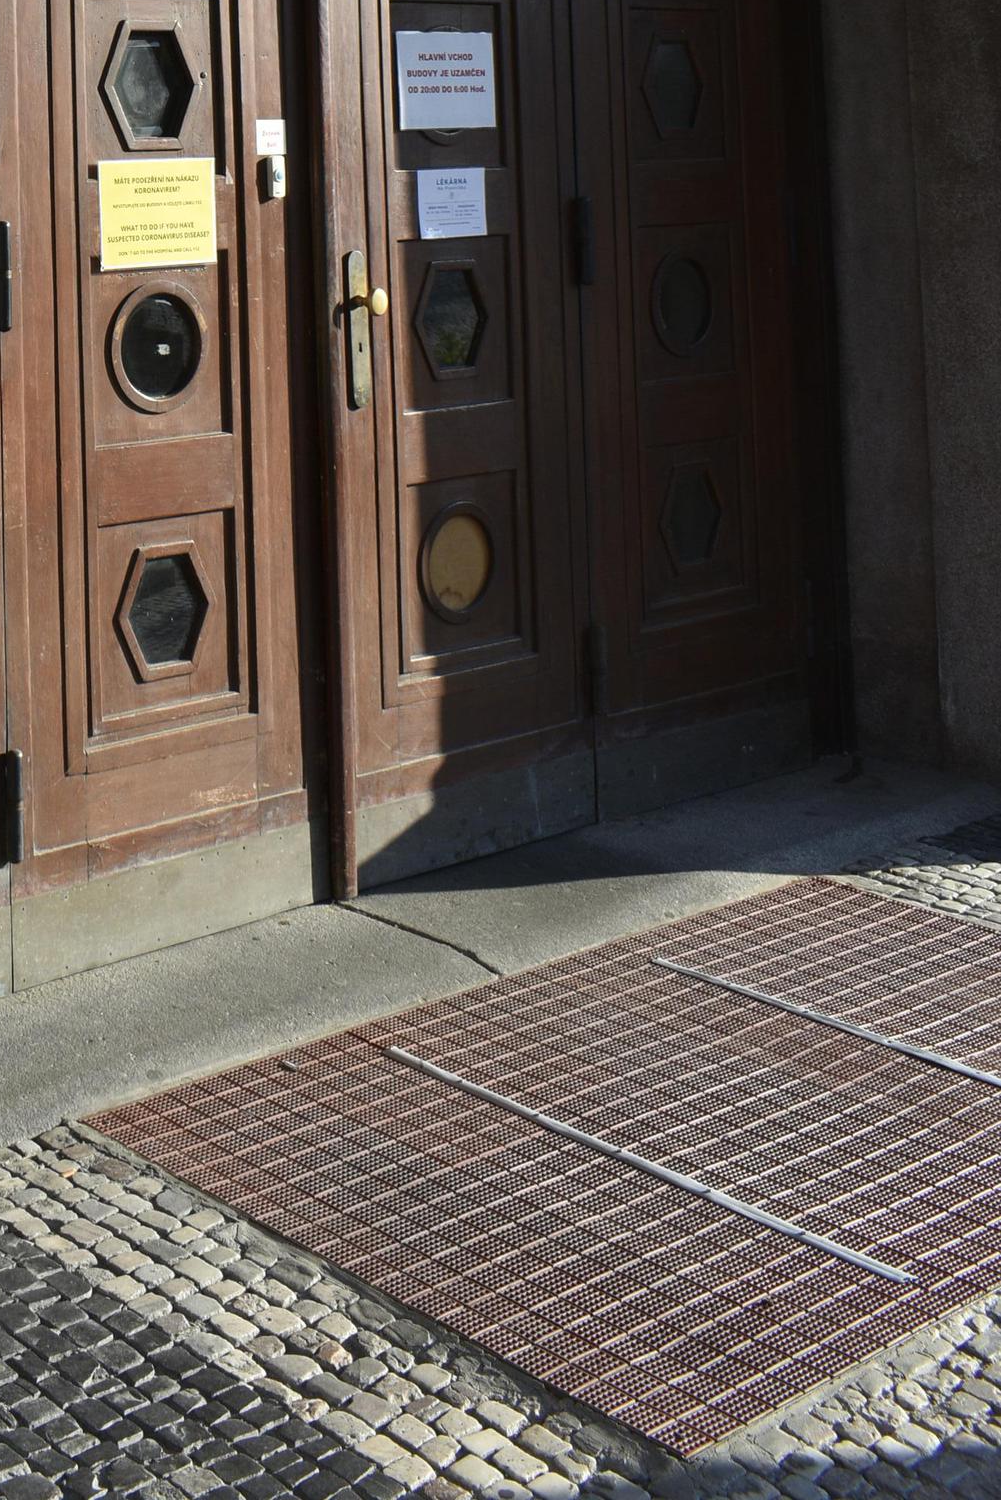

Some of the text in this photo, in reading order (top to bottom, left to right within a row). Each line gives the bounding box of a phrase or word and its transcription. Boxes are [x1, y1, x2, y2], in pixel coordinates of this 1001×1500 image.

[418, 52, 446, 60] HLAVNÍ
[451, 69, 485, 77] UZAMČEN
[114, 177, 130, 185] MÁTE
[132, 175, 164, 184] PODEZŘENÍ
[436, 177, 467, 185] LÉKÁRNA
[108, 234, 140, 243] SUSPECTED
[142, 233, 183, 241] CORONAVIRUS
